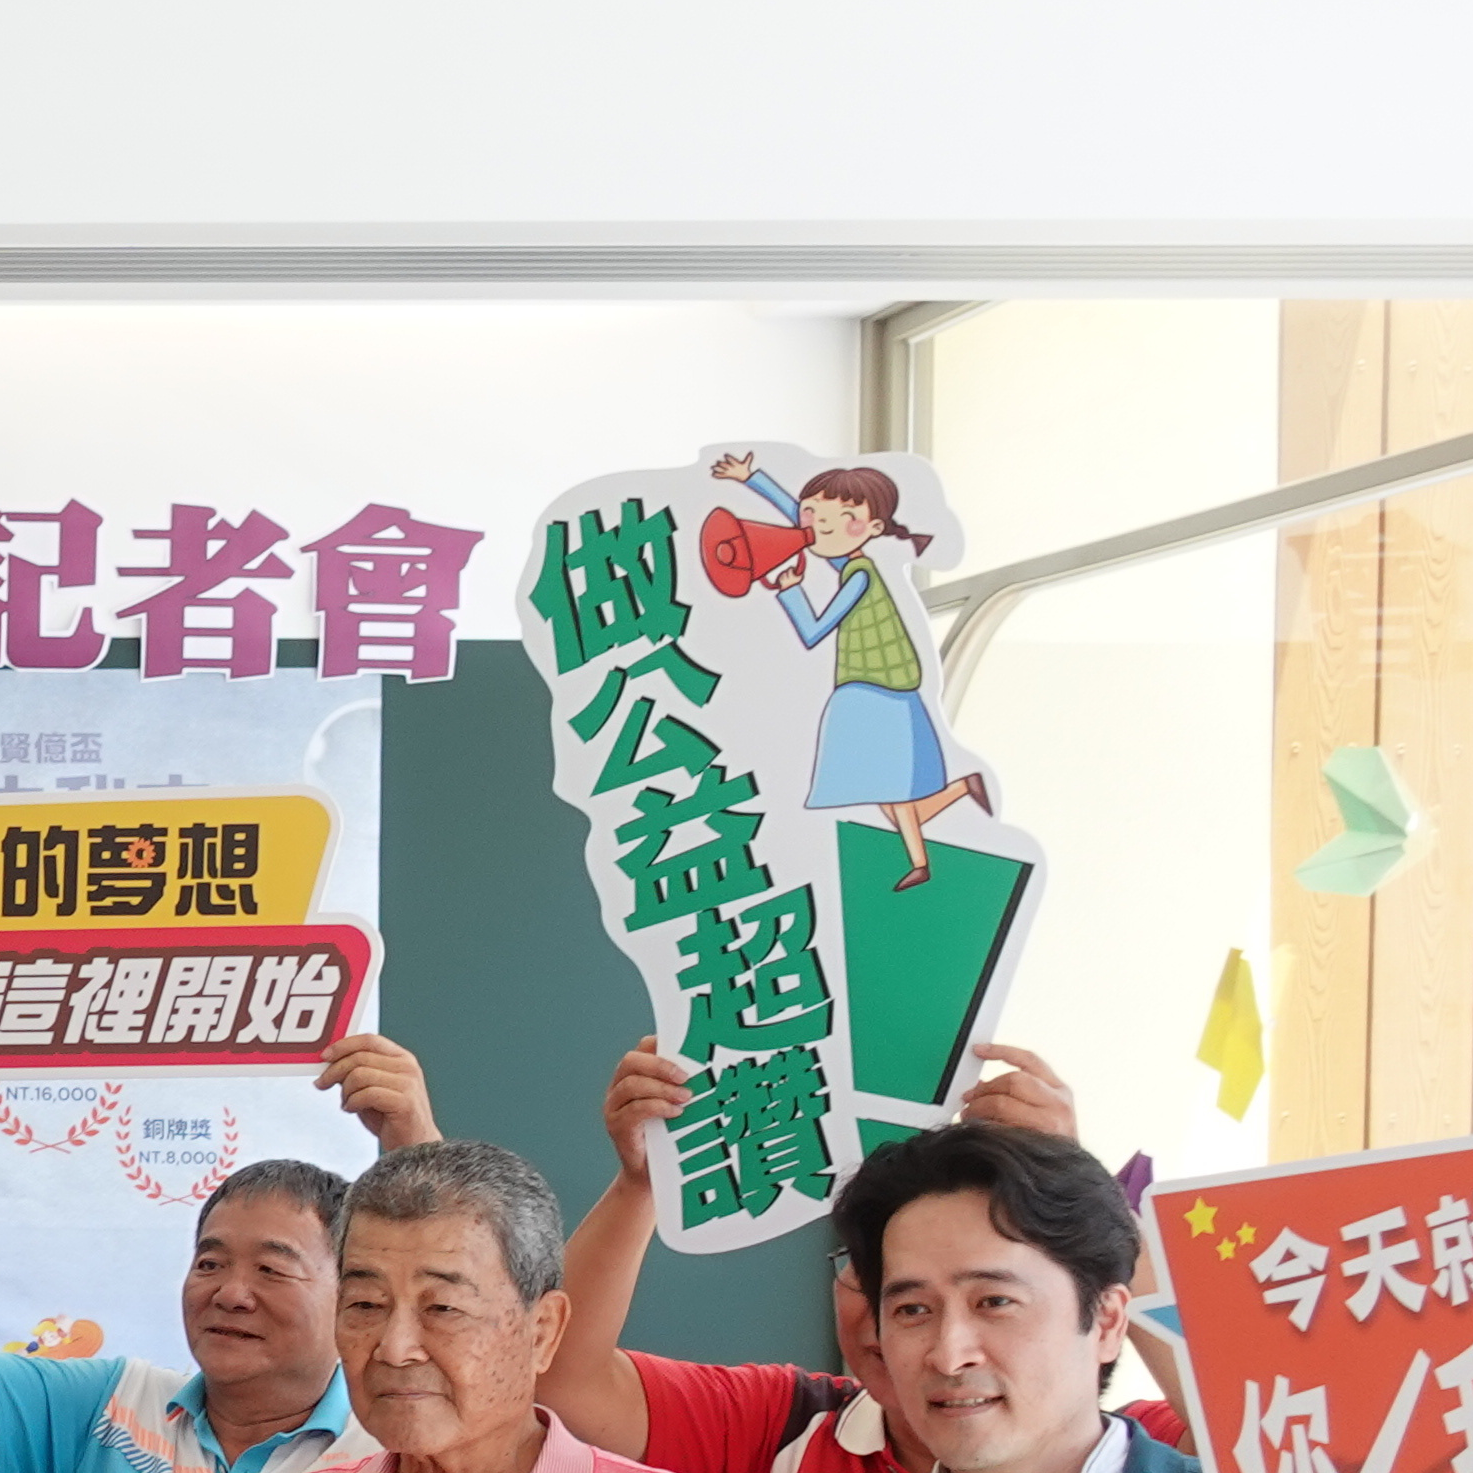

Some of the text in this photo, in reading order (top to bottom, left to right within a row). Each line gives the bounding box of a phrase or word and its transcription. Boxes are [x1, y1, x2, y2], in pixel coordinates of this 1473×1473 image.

[0, 733, 102, 763] 賢億盃
[6, 1087, 98, 1102] NT.16,000
[142, 1118, 213, 1140] 銅牌獎
[139, 1151, 217, 1166] NT.8,000
